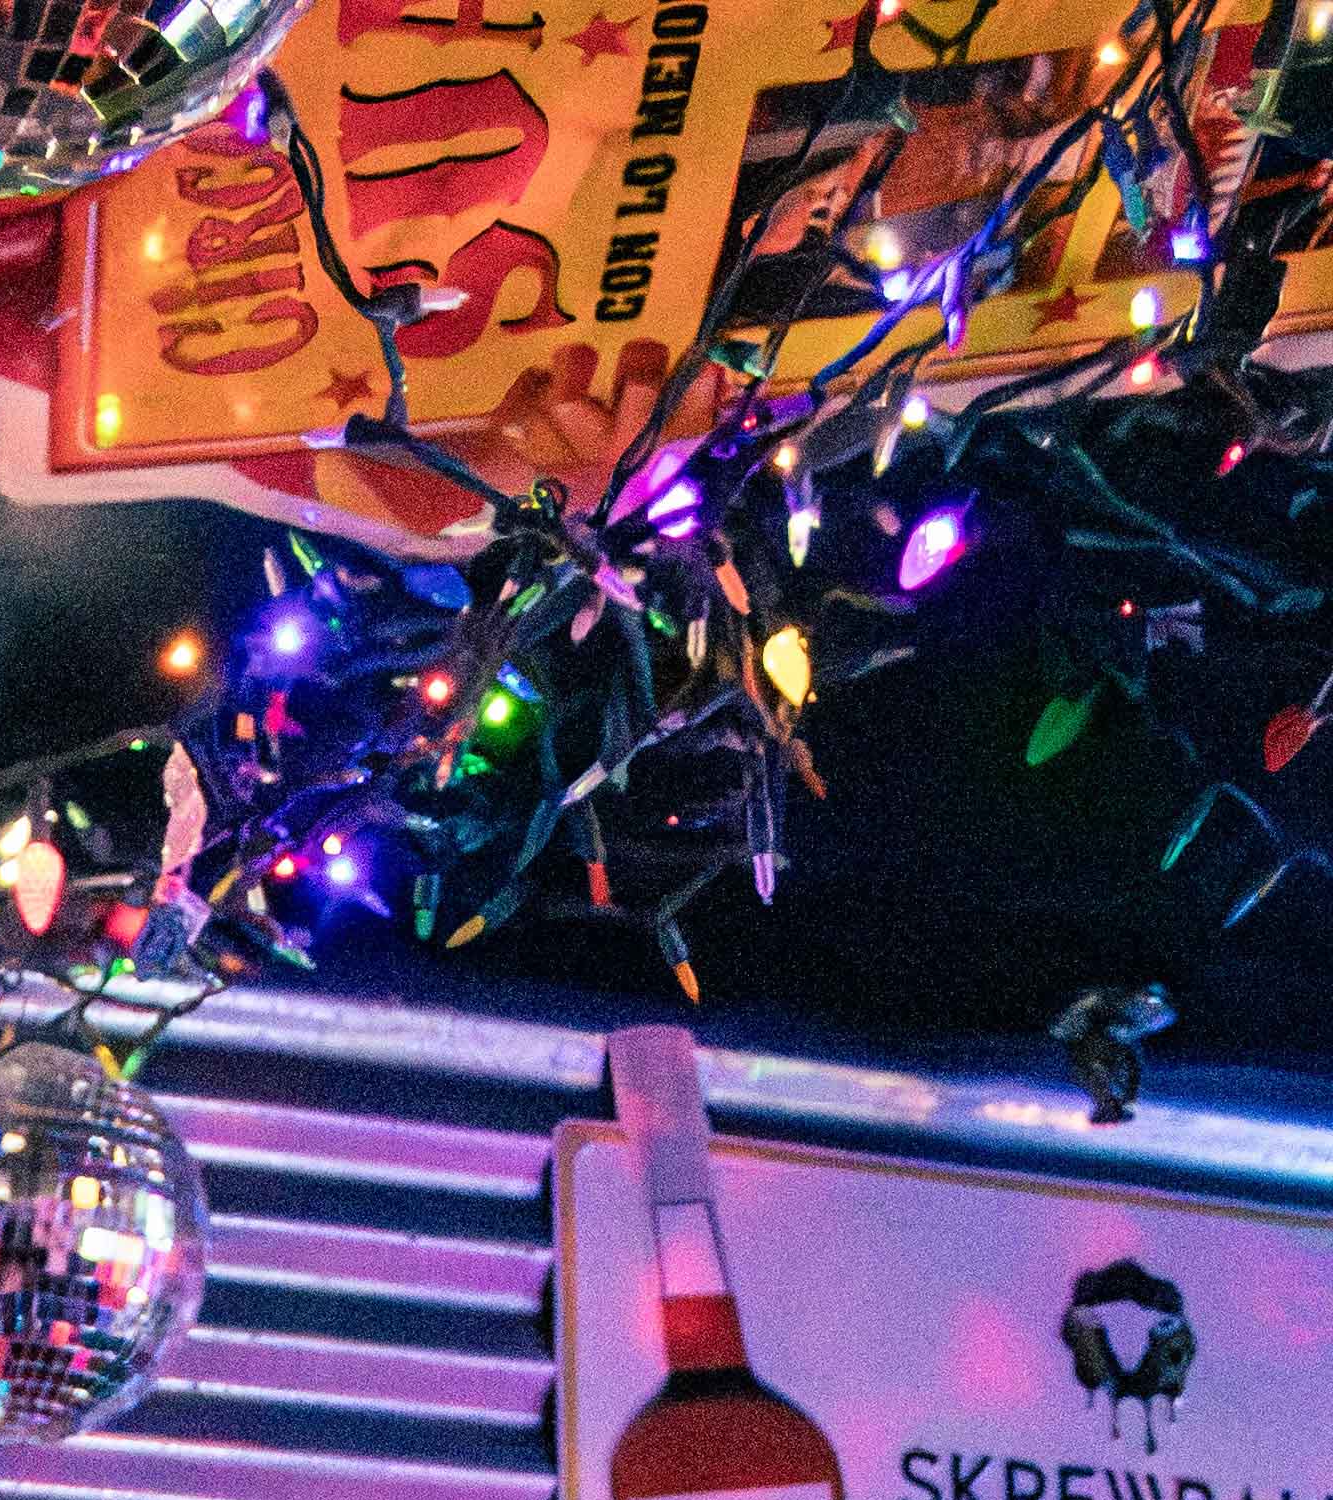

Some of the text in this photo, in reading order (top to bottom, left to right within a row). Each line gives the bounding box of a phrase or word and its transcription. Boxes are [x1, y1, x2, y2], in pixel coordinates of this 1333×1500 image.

[595, 0, 709, 324] CON LO MEJO
